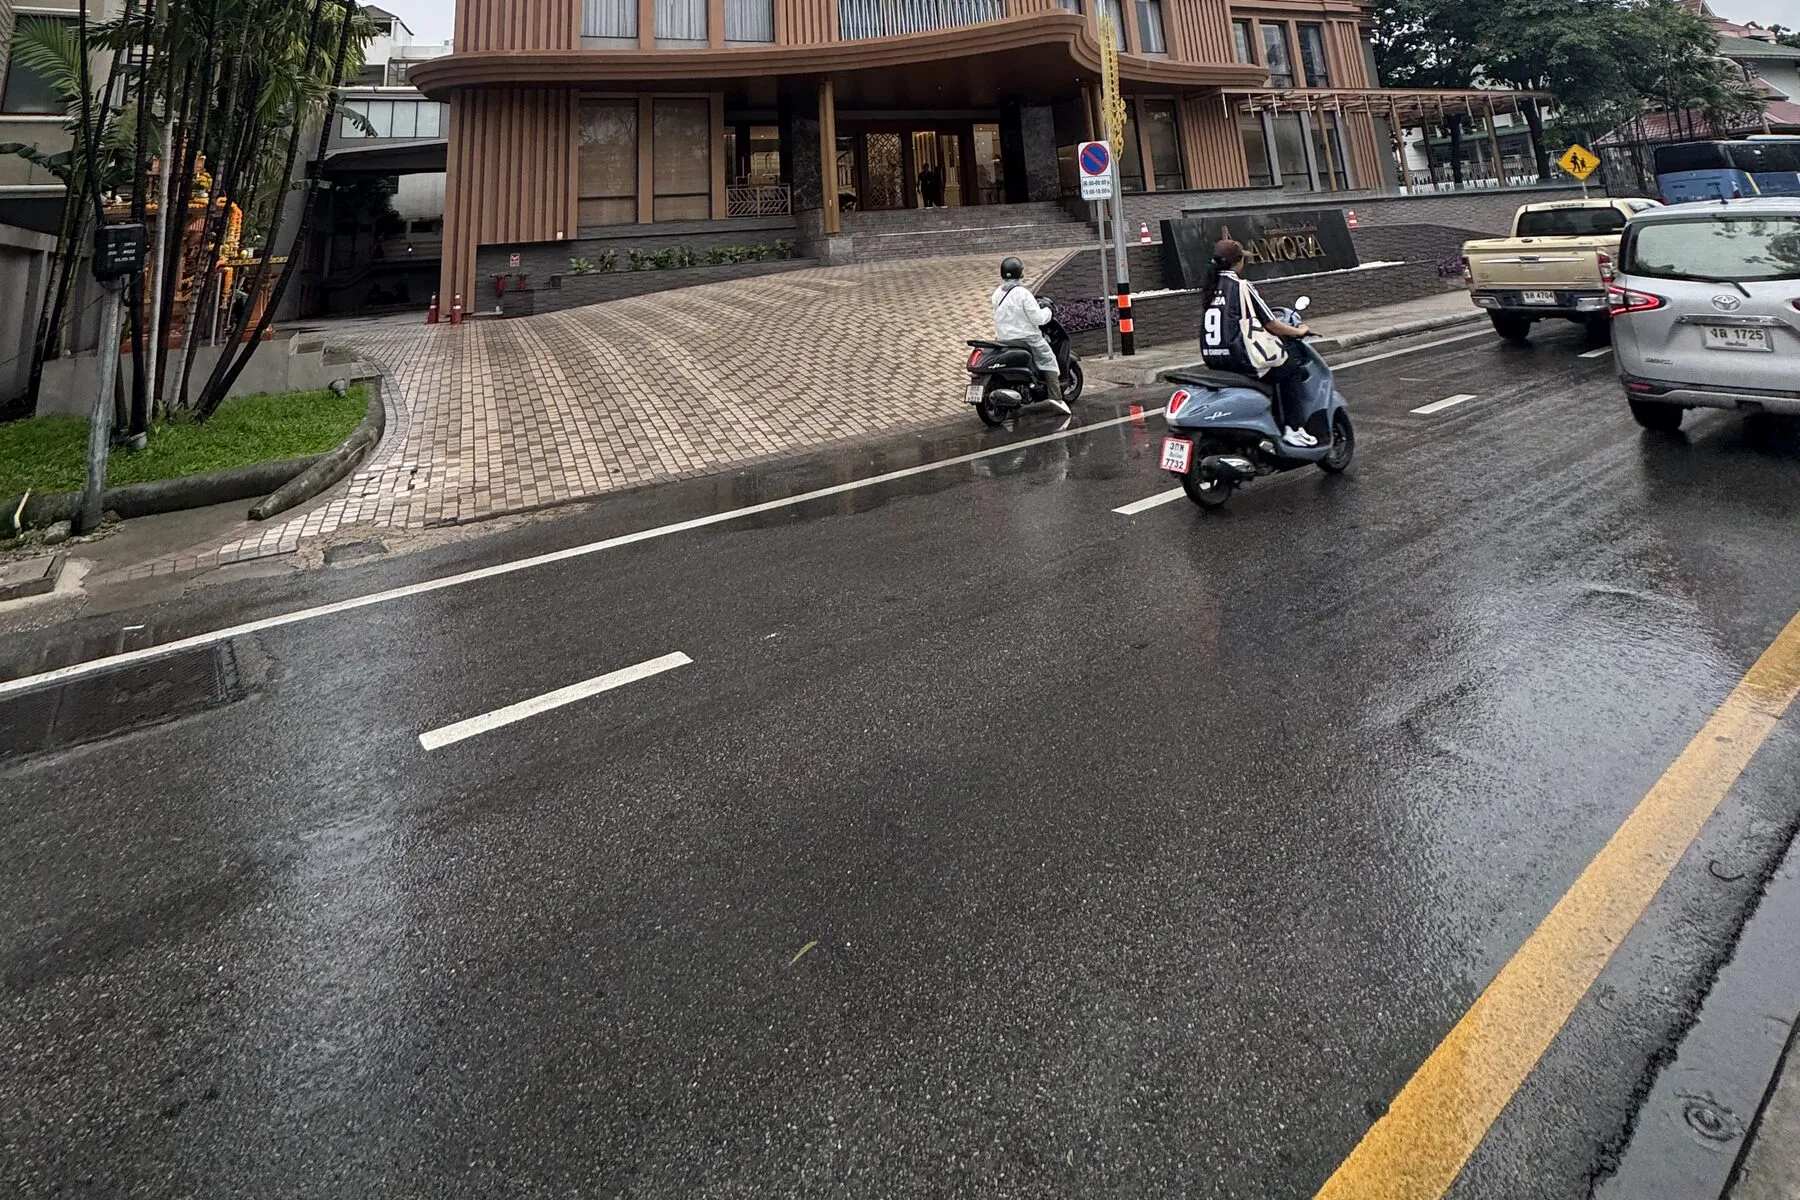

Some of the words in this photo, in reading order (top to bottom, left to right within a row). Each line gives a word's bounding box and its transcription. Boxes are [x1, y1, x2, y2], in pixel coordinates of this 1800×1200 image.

[1204, 308, 1221, 346] 9
[1734, 328, 1764, 340] 1725
[1165, 458, 1184, 469] 7732
